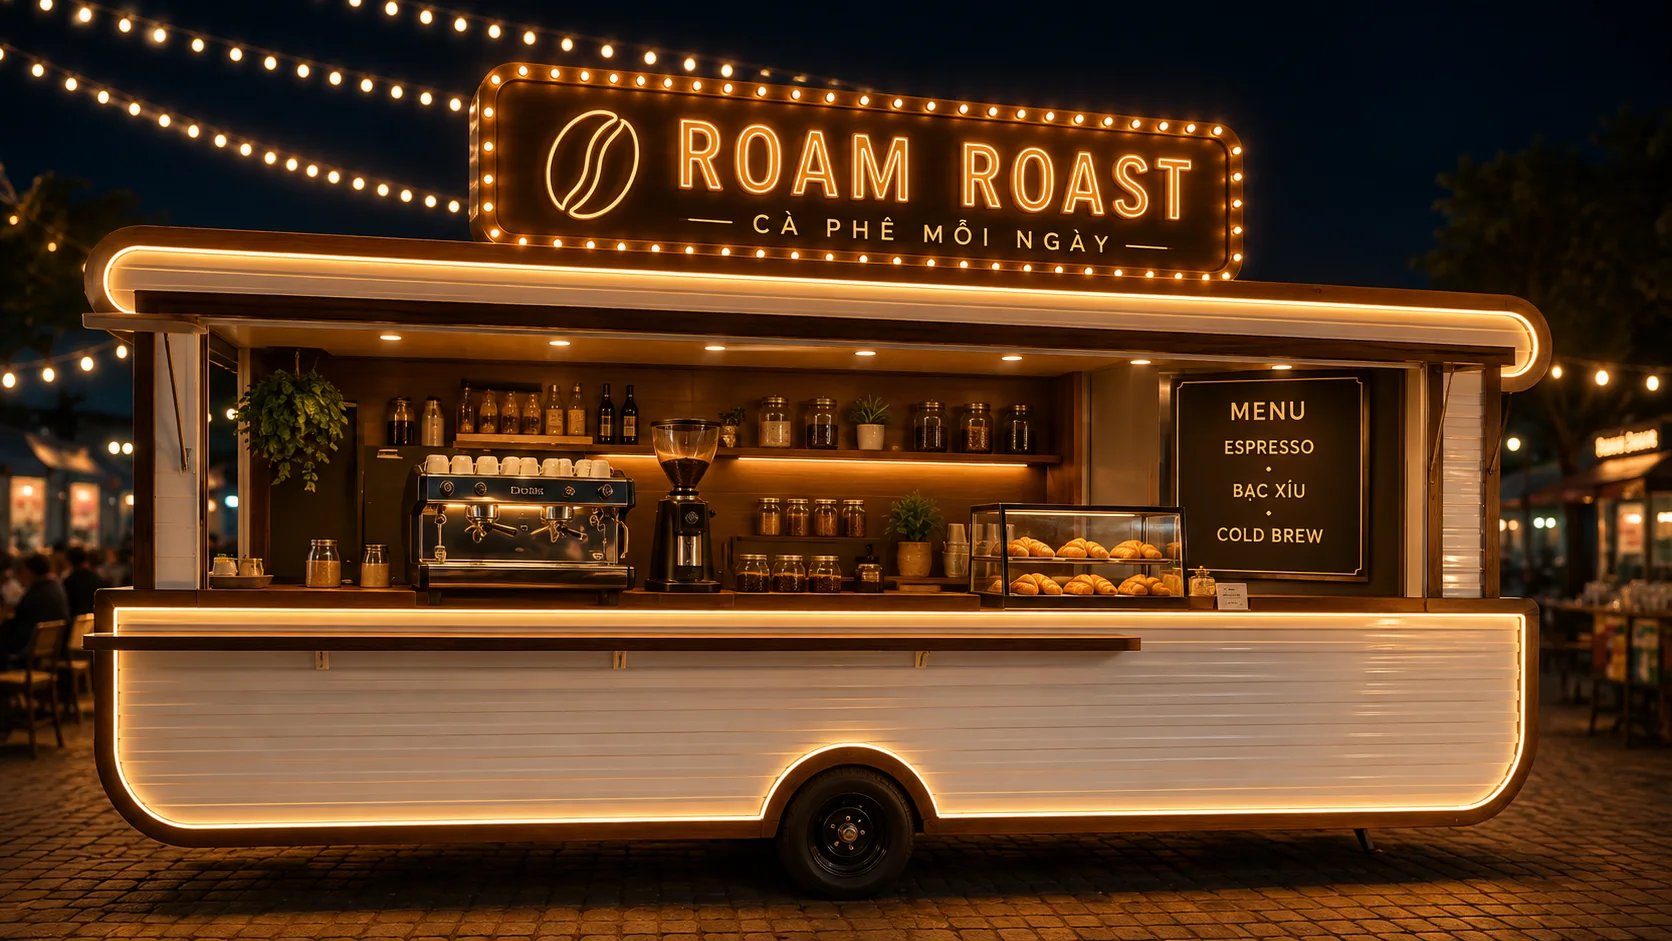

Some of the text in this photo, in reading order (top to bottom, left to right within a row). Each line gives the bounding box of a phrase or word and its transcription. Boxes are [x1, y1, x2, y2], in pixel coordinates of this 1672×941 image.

[679, 118, 1193, 220] ROAM ROAST
[753, 211, 1109, 253] CÀ PHÊ MỖI NGÀY
[1231, 400, 1306, 421] MENU
[1224, 439, 1314, 455] ESPRESSO
[1233, 479, 1305, 502] BẠC XÍU
[1217, 526, 1324, 544] COLD BREW
